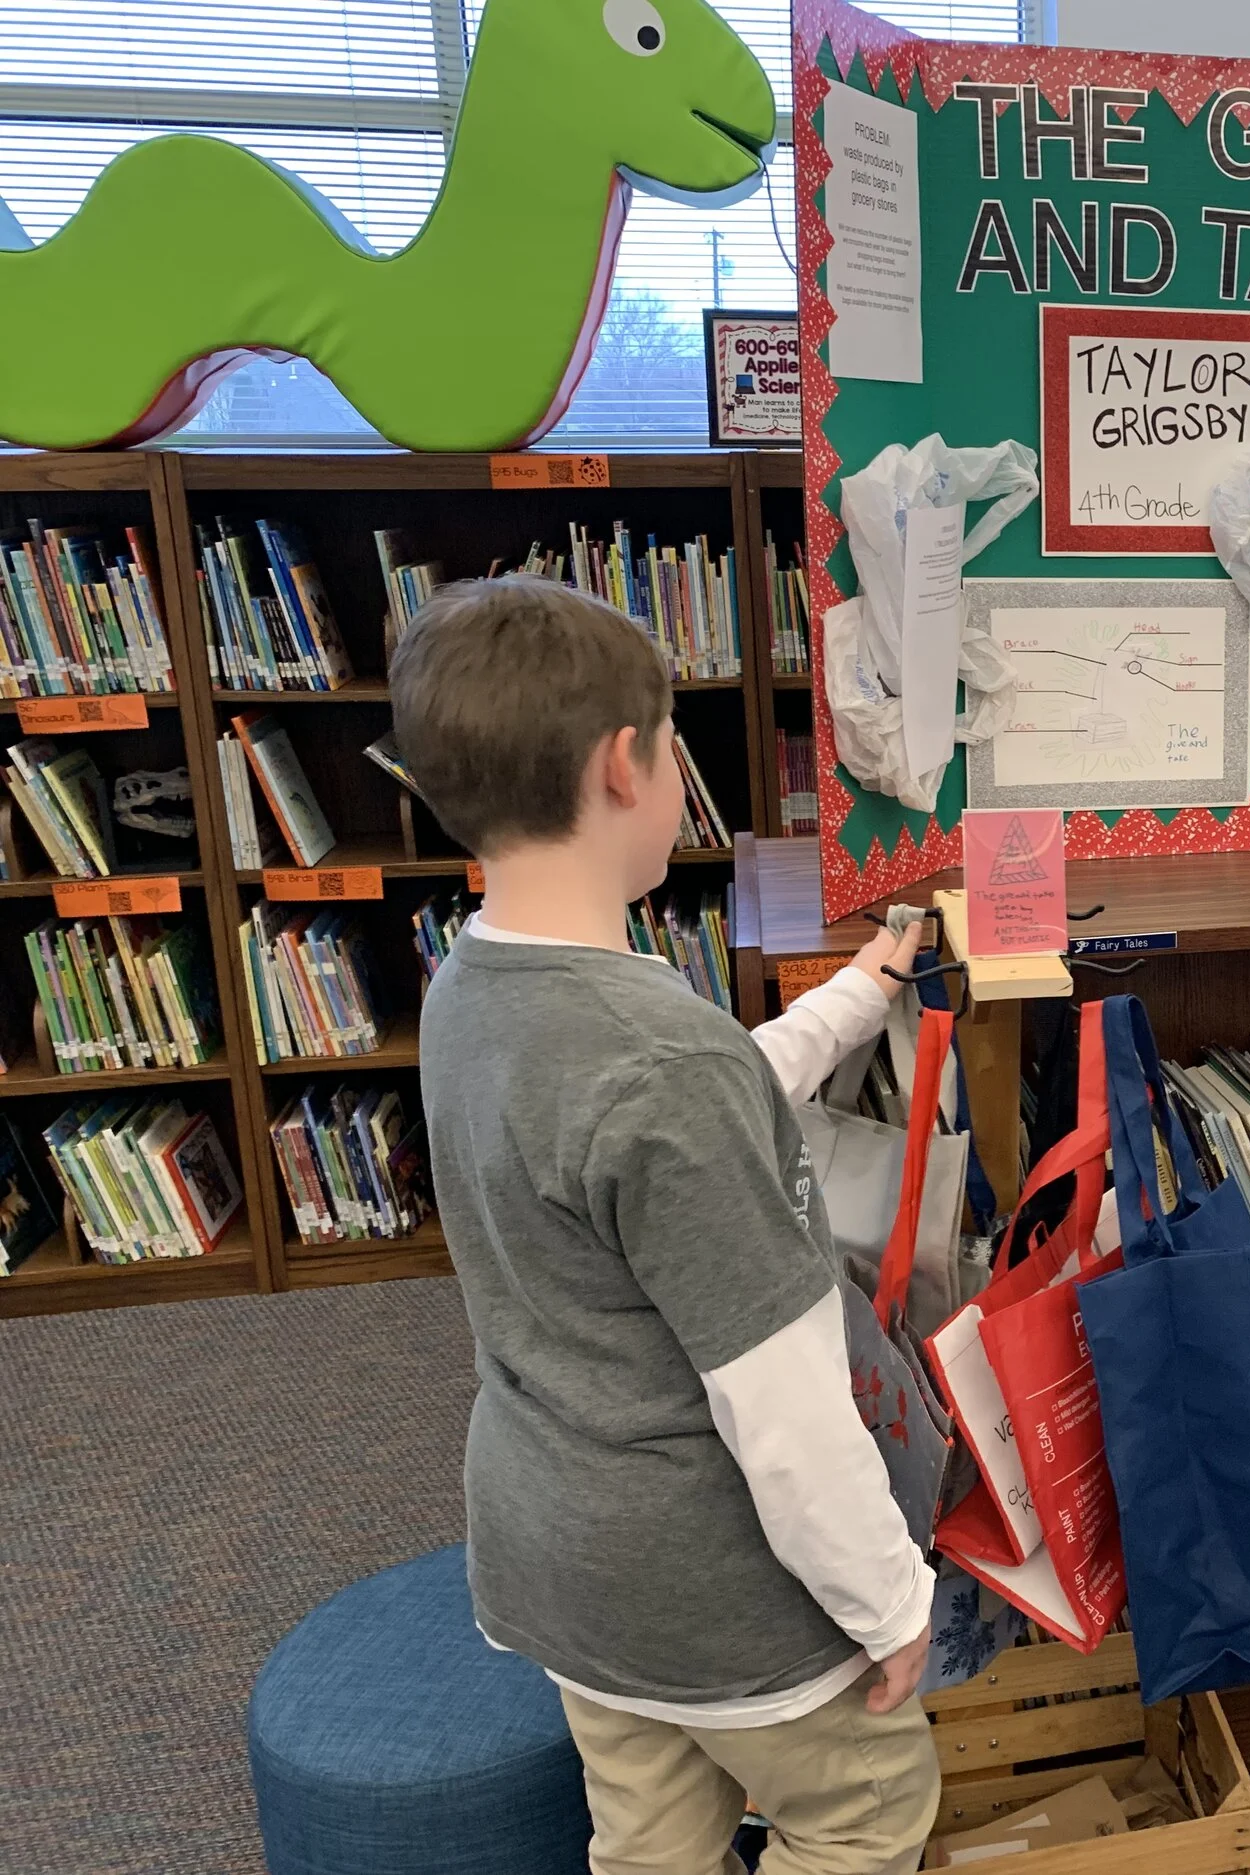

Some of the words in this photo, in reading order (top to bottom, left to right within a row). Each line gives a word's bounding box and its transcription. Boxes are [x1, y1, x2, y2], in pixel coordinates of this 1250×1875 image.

[953, 82, 1149, 183] THE
[843, 146, 862, 162] waste
[864, 153, 893, 171] produced
[895, 160, 904, 177] by
[851, 169, 871, 185] plastic
[873, 174, 889, 192] bags
[851, 192, 876, 210] grocery
[877, 199, 898, 213] stores
[956, 200, 1183, 295] AND
[735, 339, 798, 356] 600-69
[744, 357, 799, 376] Applie
[1093, 403, 1247, 448] GRIGSBY
[513, 467, 538, 478] Bugs
[1078, 483, 1119, 523] 4th
[1125, 482, 1200, 520] Grade
[21, 714, 75, 723] Dinosaurs
[1168, 724, 1199, 738] The
[77, 884, 111, 893] Plants
[288, 874, 314, 883] Birds
[1095, 941, 1120, 951] Fairy
[1124, 939, 1148, 948] Tales
[1035, 1422, 1056, 1463] CLEAN
[1058, 1509, 1077, 1544] PAINT
[1074, 1572, 1085, 1589] UP
[1078, 1587, 1105, 1625] CLEAN
